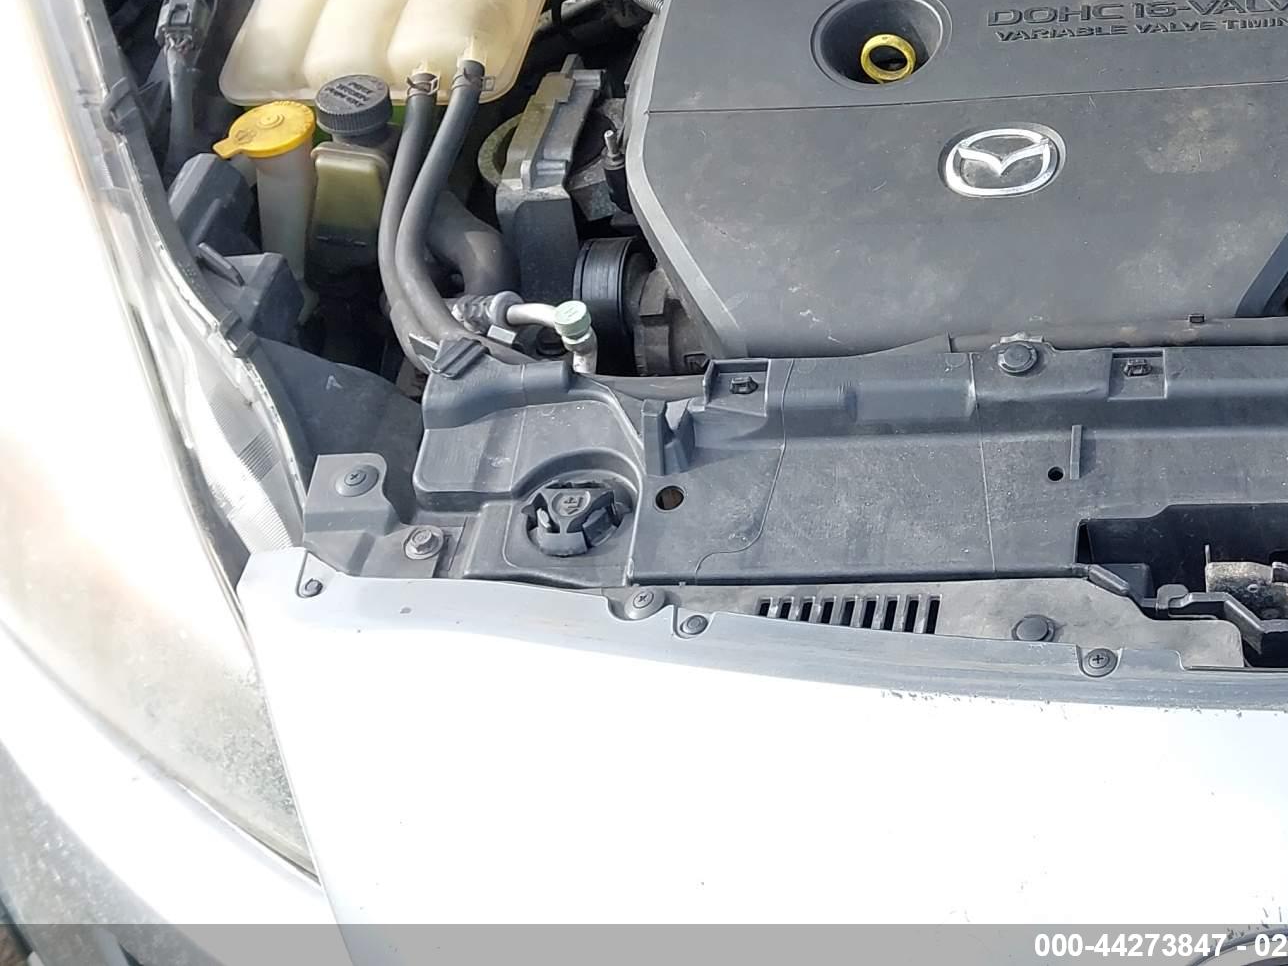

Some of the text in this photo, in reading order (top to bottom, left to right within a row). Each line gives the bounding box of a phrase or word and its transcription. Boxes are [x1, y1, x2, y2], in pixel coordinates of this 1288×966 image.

[987, 4, 1124, 27] DOHC
[995, 24, 1129, 42] VARIABLE
[1134, 19, 1217, 35] VALVE
